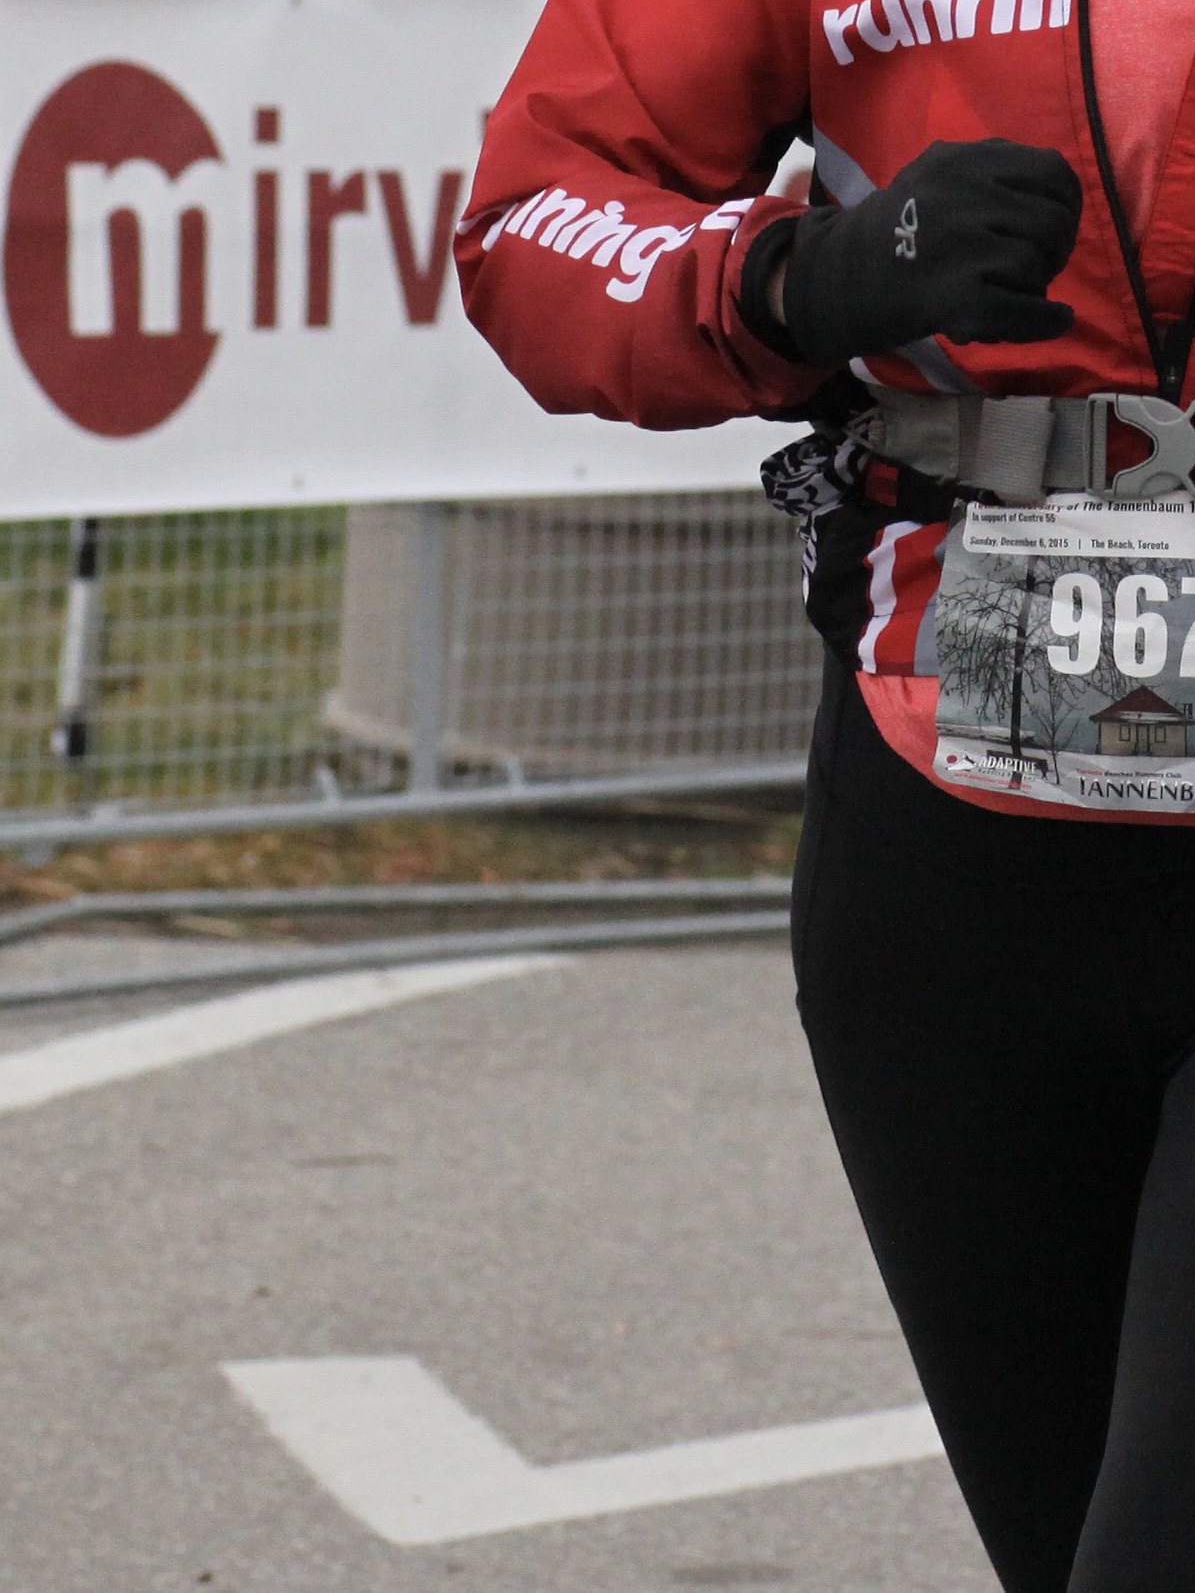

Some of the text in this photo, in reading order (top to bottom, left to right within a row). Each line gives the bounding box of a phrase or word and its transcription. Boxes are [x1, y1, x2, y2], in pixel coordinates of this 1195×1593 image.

[66, 107, 491, 339] mirv
[1107, 500, 1185, 513] Tannenbaum
[1000, 537, 1037, 547] December
[1049, 538, 1069, 548] 2015
[979, 756, 1037, 773] ADAPTIVE
